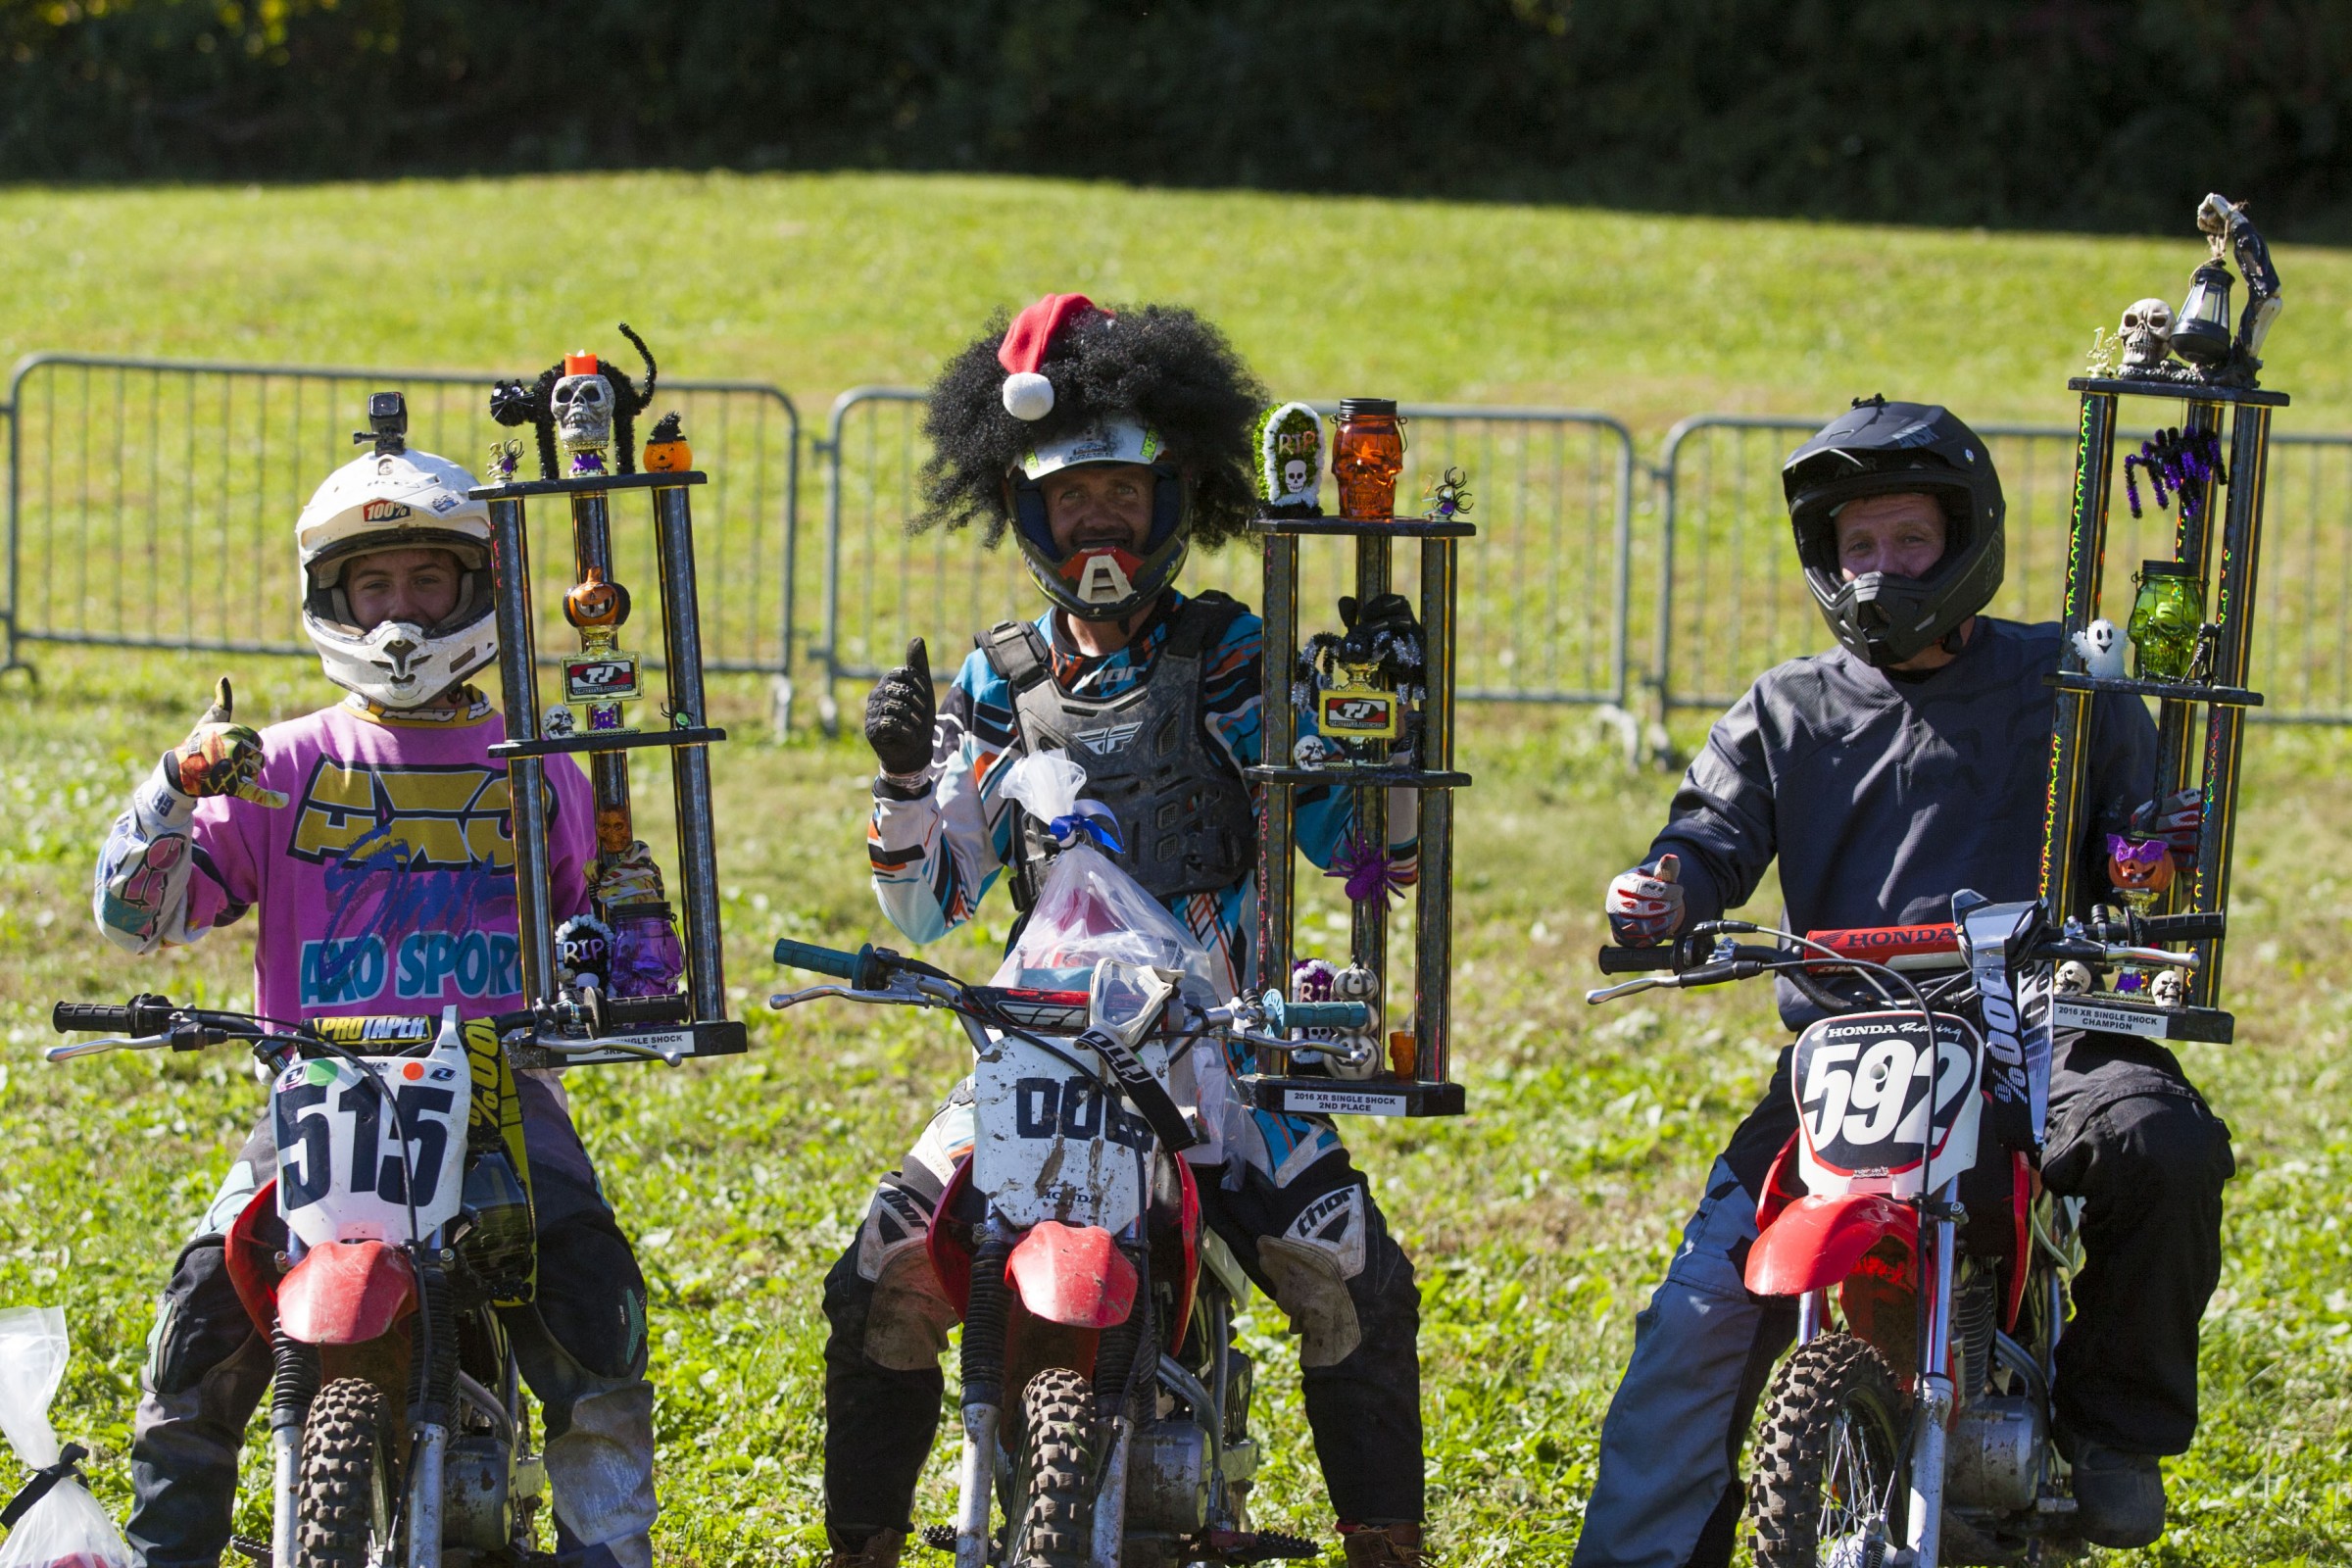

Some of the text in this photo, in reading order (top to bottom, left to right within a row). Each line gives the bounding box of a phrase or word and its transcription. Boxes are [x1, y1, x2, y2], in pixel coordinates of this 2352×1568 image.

[1278, 430, 1316, 455] RIP
[367, 502, 408, 518] 100%
[586, 665, 615, 684] TJ
[1344, 702, 1372, 719] TJ
[1846, 927, 1957, 948] HONDA
[563, 938, 605, 963] RIP
[301, 933, 388, 1006] AXO
[1299, 982, 1328, 1004] RI
[2058, 1005, 2158, 1025] 2016 XR SINGLE SHOCK
[2082, 1017, 2133, 1031] CHAMPION
[651, 1034, 683, 1044] SHOCK
[1828, 1024, 1897, 1038] HONDA
[1081, 1029, 1154, 1084] tho
[1294, 1092, 1315, 1101] 2016
[1331, 1095, 1363, 1103] SINGLE
[1365, 1097, 1396, 1105] SHOCK
[1802, 1039, 1973, 1152] 592
[1319, 1102, 1372, 1112] 2ND PLACE
[275, 1075, 455, 1211] 515
[1296, 1187, 1355, 1238] thor
